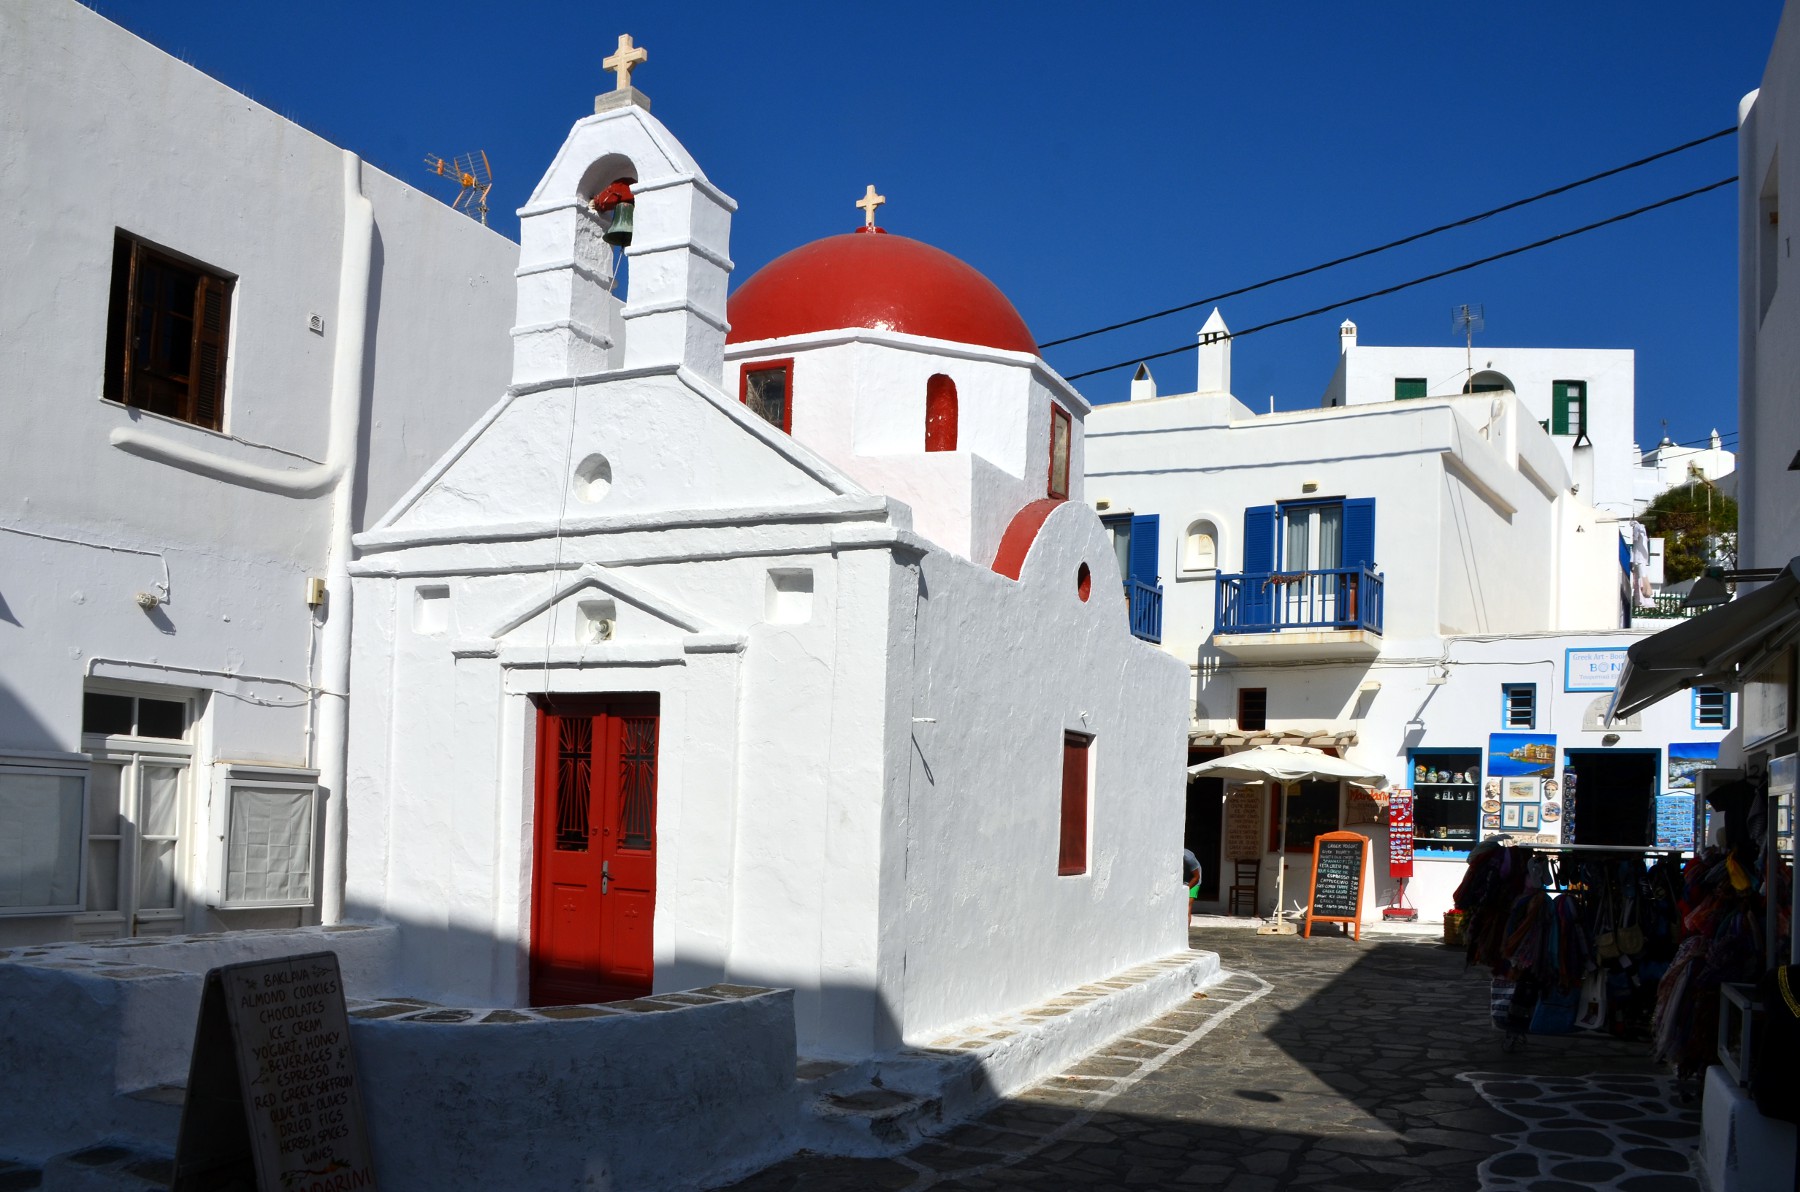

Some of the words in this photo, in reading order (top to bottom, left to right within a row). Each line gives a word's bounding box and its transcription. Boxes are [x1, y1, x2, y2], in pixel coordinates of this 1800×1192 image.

[264, 969, 309, 987] BAKLAVA
[241, 989, 285, 1008] ALMOND
[294, 980, 336, 999] COOKIES
[260, 1000, 324, 1023] CHOCOLATES
[270, 1024, 285, 1040] ICE
[292, 1018, 322, 1035] CREAM
[252, 1040, 297, 1060] YOGURT
[306, 1031, 339, 1049] HONEY
[267, 1047, 332, 1073] BEVERAGES
[277, 1063, 329, 1087] ESPRESSO
[255, 1092, 276, 1110] RED
[281, 1083, 314, 1102] GREEK
[315, 1075, 353, 1095] SAFFRON
[271, 1105, 295, 1122] OLIVE
[280, 1118, 311, 1137] DRIED
[319, 1109, 343, 1127] FIGS
[280, 1133, 309, 1155] HERBS
[317, 1123, 348, 1144] SPICES
[303, 1145, 333, 1165] WINES
